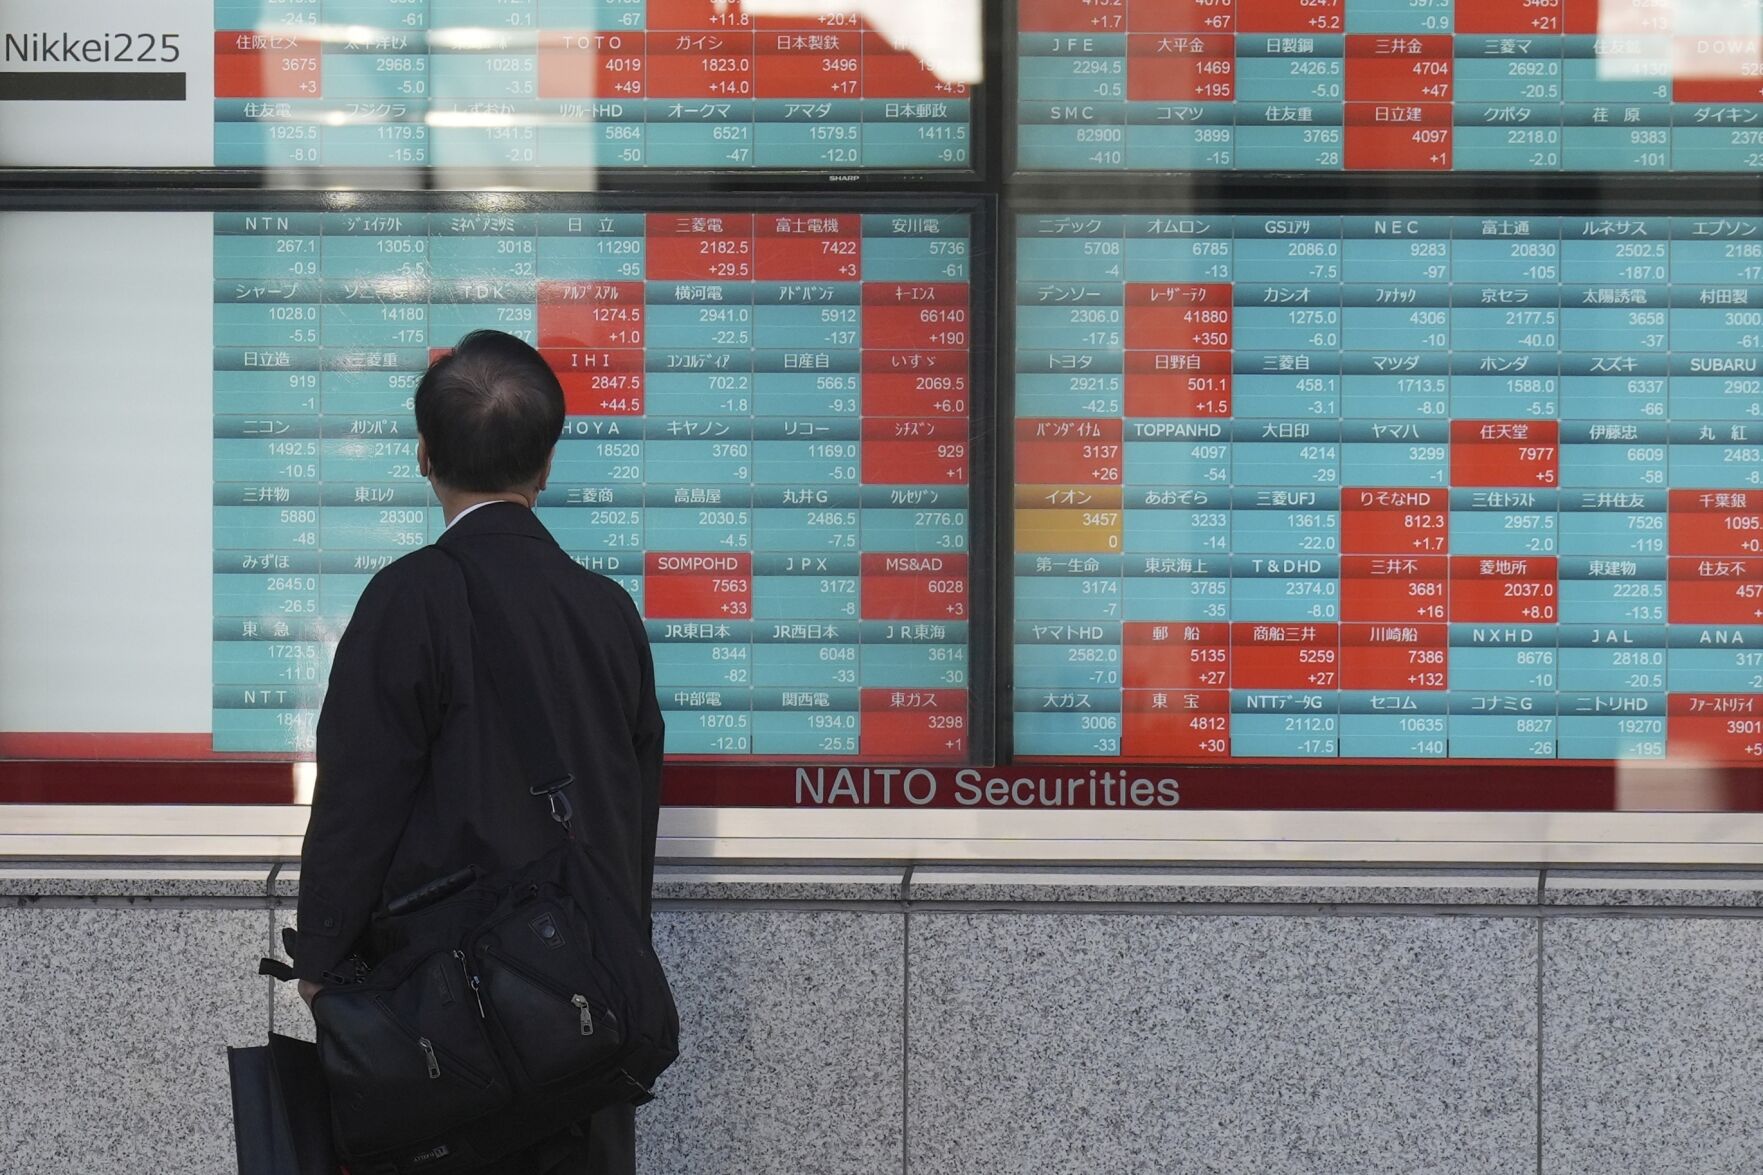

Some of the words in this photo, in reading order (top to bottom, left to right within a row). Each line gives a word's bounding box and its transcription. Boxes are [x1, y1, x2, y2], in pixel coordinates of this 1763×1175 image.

[5, 33, 181, 63] Nikkei225
[676, 36, 723, 50] ガイシ
[778, 35, 839, 50] 日本製鉄
[1158, 38, 1204, 52] 大平金
[1267, 38, 1313, 53] 日製鋼
[1376, 38, 1422, 53] 三井金
[1484, 39, 1532, 54] 三菱マ
[702, 59, 748, 71] 1823.0
[823, 59, 857, 71] 3496
[1197, 61, 1230, 74] 1469
[1413, 62, 1448, 74] 4704
[1509, 62, 1557, 75] 2692.0
[935, 82, 965, 93] +4.5
[1312, 84, 1339, 97] -5.0
[668, 103, 730, 118] オークマ
[785, 103, 831, 118] アマダ
[886, 102, 947, 117] 日本郵政
[1158, 107, 1203, 120] コマツ
[1265, 106, 1313, 122] 住友重
[1376, 107, 1421, 121] 日立建
[1694, 107, 1758, 122] ダイキン
[606, 126, 640, 139] 5864
[713, 127, 747, 139] 6521
[918, 127, 965, 139] 1411.5
[1077, 129, 1121, 142] 82900
[1304, 130, 1338, 142] 3765
[1412, 130, 1447, 143] 4097
[1631, 131, 1666, 143] 9383
[821, 149, 857, 161] -12.0
[1529, 153, 1556, 165] -2.0
[776, 217, 839, 232] 富士電機
[892, 218, 939, 233] 安川電
[1147, 219, 1210, 234] オムロン
[1482, 220, 1529, 235] 富士通
[1582, 220, 1647, 235] ルネサス
[277, 240, 314, 252] 267.1
[498, 240, 532, 253] 3018
[822, 241, 856, 254] 7422
[930, 242, 964, 254] 5736
[1193, 243, 1228, 255] 6785
[1511, 244, 1555, 256] 20830
[1616, 244, 1664, 257] 2502.5
[709, 263, 748, 275] +29.5
[675, 285, 722, 300] 横河電
[1039, 286, 1100, 301] デンソー
[1264, 288, 1310, 302] カシオ
[1482, 288, 1528, 303] 京セラ
[1582, 288, 1647, 303] 太陽誘電
[1700, 289, 1747, 304] 村田製
[700, 309, 748, 321] 2941.0
[822, 309, 856, 322] 5912
[1184, 311, 1227, 323] 41880
[1410, 312, 1445, 324] 4306
[1506, 312, 1554, 324] 2177.5
[289, 329, 316, 342] -5.5
[609, 331, 639, 343] +1.0
[929, 332, 964, 344] +190
[1309, 333, 1336, 346] -6.0
[245, 351, 290, 366] 日立造
[785, 353, 829, 368] 日産自
[892, 354, 936, 368] いすゞ
[1050, 354, 1092, 369] トヨタ
[1156, 354, 1200, 369] 日野自
[1263, 355, 1309, 370] 三菱自
[1372, 355, 1419, 370] マツダ
[1480, 356, 1529, 371] ホンダ
[1590, 356, 1638, 371] スズキ
[1691, 358, 1756, 371] SUBARU
[290, 375, 316, 387] 919
[592, 376, 639, 389] 2847.5
[709, 376, 747, 389] 702.2
[916, 377, 964, 390] 2069.5
[1070, 377, 1118, 390] 2921.5
[1296, 379, 1334, 391] 458.1
[1398, 379, 1445, 392] 1713.5
[1628, 380, 1664, 393] 6337
[829, 399, 855, 412] -9.3
[1197, 401, 1227, 413] +1.5
[1527, 402, 1554, 415] -5.5
[667, 420, 729, 435] キヤノン
[785, 421, 830, 435] リコー
[1134, 424, 1221, 436] TOPPANHD
[1372, 424, 1419, 438] ヤマハ
[1480, 424, 1528, 439] 任天堂
[269, 442, 315, 455] 1492.5
[809, 445, 855, 457] 1169.0
[938, 445, 963, 457] 929
[1191, 446, 1226, 459] 4097
[1519, 448, 1554, 460] 7977
[1627, 448, 1663, 461] 6609
[243, 486, 289, 502] 三井物
[567, 487, 614, 502] 三菱商
[675, 488, 720, 503] 高島屋
[1045, 489, 1091, 504] イオン
[1145, 490, 1207, 504] あおぞら
[1361, 492, 1430, 506] りそなHD
[1582, 492, 1644, 507] 三井住友
[1699, 493, 1746, 508] 千葉銀
[699, 512, 747, 524] 2030.5
[808, 512, 855, 525] 2486.5
[1192, 514, 1226, 526] 3233
[1405, 515, 1444, 527] 812.3
[1504, 516, 1553, 528] 2957.5
[603, 534, 639, 546] -21.5
[936, 535, 963, 547] -3.0
[1299, 536, 1335, 549] -22.0
[1631, 539, 1663, 551] -119
[243, 553, 289, 569] みずほ
[658, 557, 737, 570] SOMPOHD
[1037, 557, 1099, 572] 第一生命
[1144, 557, 1208, 573] 東京海上
[1371, 559, 1417, 574] 三井不
[1480, 560, 1527, 575] 菱地所
[1588, 560, 1636, 576] 東建物
[1698, 561, 1745, 576] 住友不
[267, 578, 315, 590] 2645.0
[712, 579, 747, 592] 7563
[929, 580, 963, 593] 6028
[1083, 581, 1118, 593] 3174
[1286, 582, 1334, 595] 2374.0
[1409, 583, 1441, 595] 3681
[1614, 584, 1662, 597] 2228.5
[1522, 606, 1552, 618] +8.0
[665, 623, 730, 639] JR東日本
[1032, 625, 1103, 640] ヤマトHD
[1254, 626, 1316, 641] 商船三井
[1370, 627, 1417, 642] 川崎船
[820, 648, 855, 660] 6048
[928, 648, 963, 661] 3614
[1191, 649, 1225, 662] 5135
[1517, 651, 1552, 664] 8676
[1613, 652, 1662, 665] 2818.0
[1089, 671, 1116, 683] -7.0
[1408, 673, 1443, 685] +132
[675, 691, 721, 706] 中部電
[783, 692, 830, 706] 関西電
[890, 692, 937, 707] 東ガス
[1370, 696, 1417, 709] セコム
[1576, 696, 1648, 711] ニトリHD
[700, 715, 746, 727] 1870.5
[808, 715, 854, 728] 1934.0
[1190, 717, 1225, 730] 4812
[1400, 719, 1443, 731] 10635
[1517, 720, 1552, 732] 8827
[1298, 740, 1334, 752] -17.5
[1630, 742, 1661, 755] -195
[795, 768, 937, 806] NAITO
[955, 770, 1180, 807] Securities
